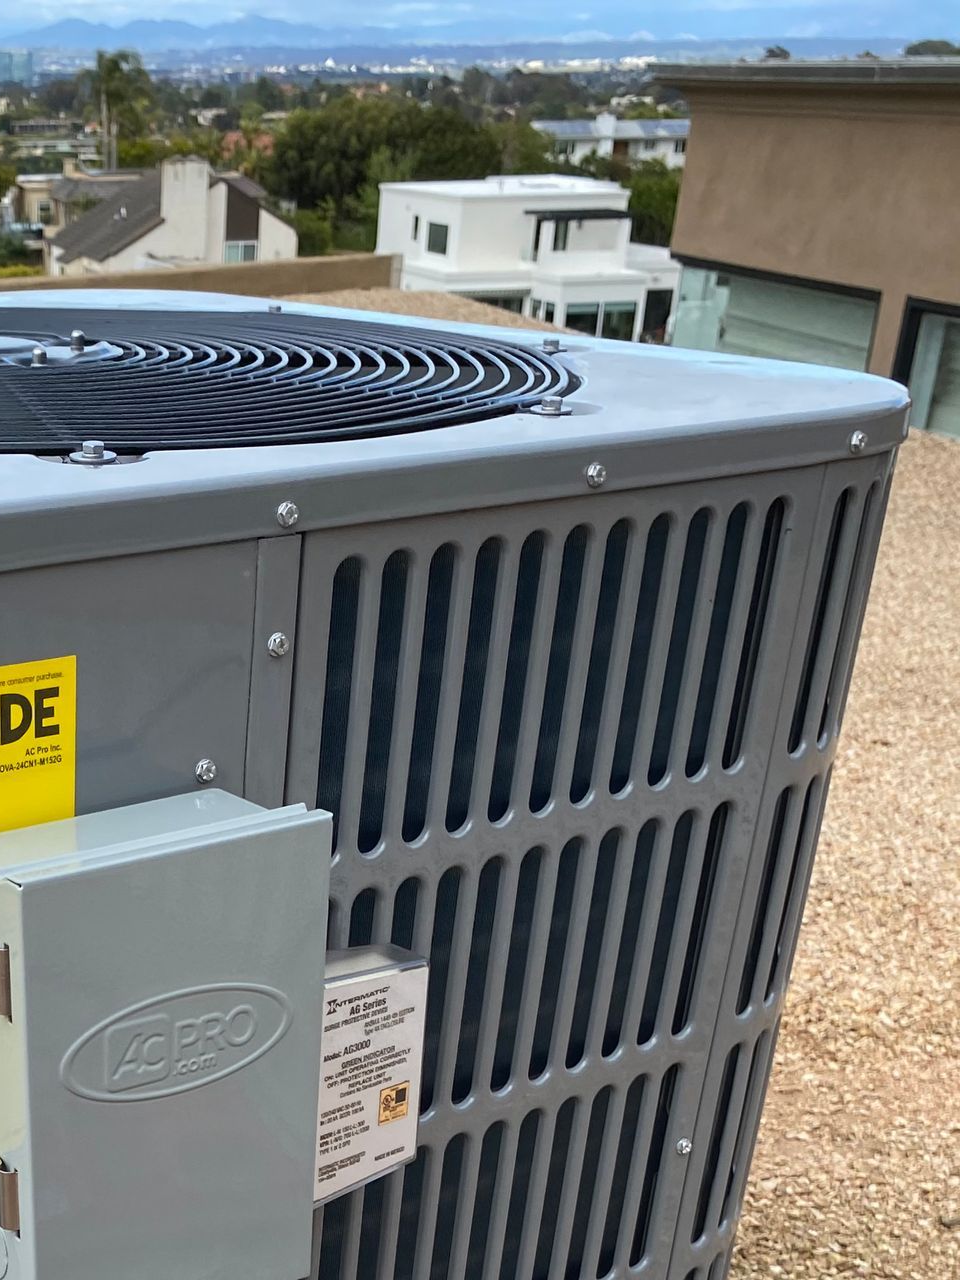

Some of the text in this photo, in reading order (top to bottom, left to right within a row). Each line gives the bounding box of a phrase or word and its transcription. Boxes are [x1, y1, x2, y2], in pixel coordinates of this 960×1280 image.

[7, 675, 35, 687] consumer
[36, 670, 64, 683] purchase.
[25, 742, 63, 757] AC Pro Inc.
[326, 986, 391, 1016] INTERMATIC
[349, 997, 387, 1017] AG Series
[112, 1003, 257, 1081] AC PRO
[343, 1038, 371, 1057] AG3000
[362, 1045, 396, 1063] INDICATOR
